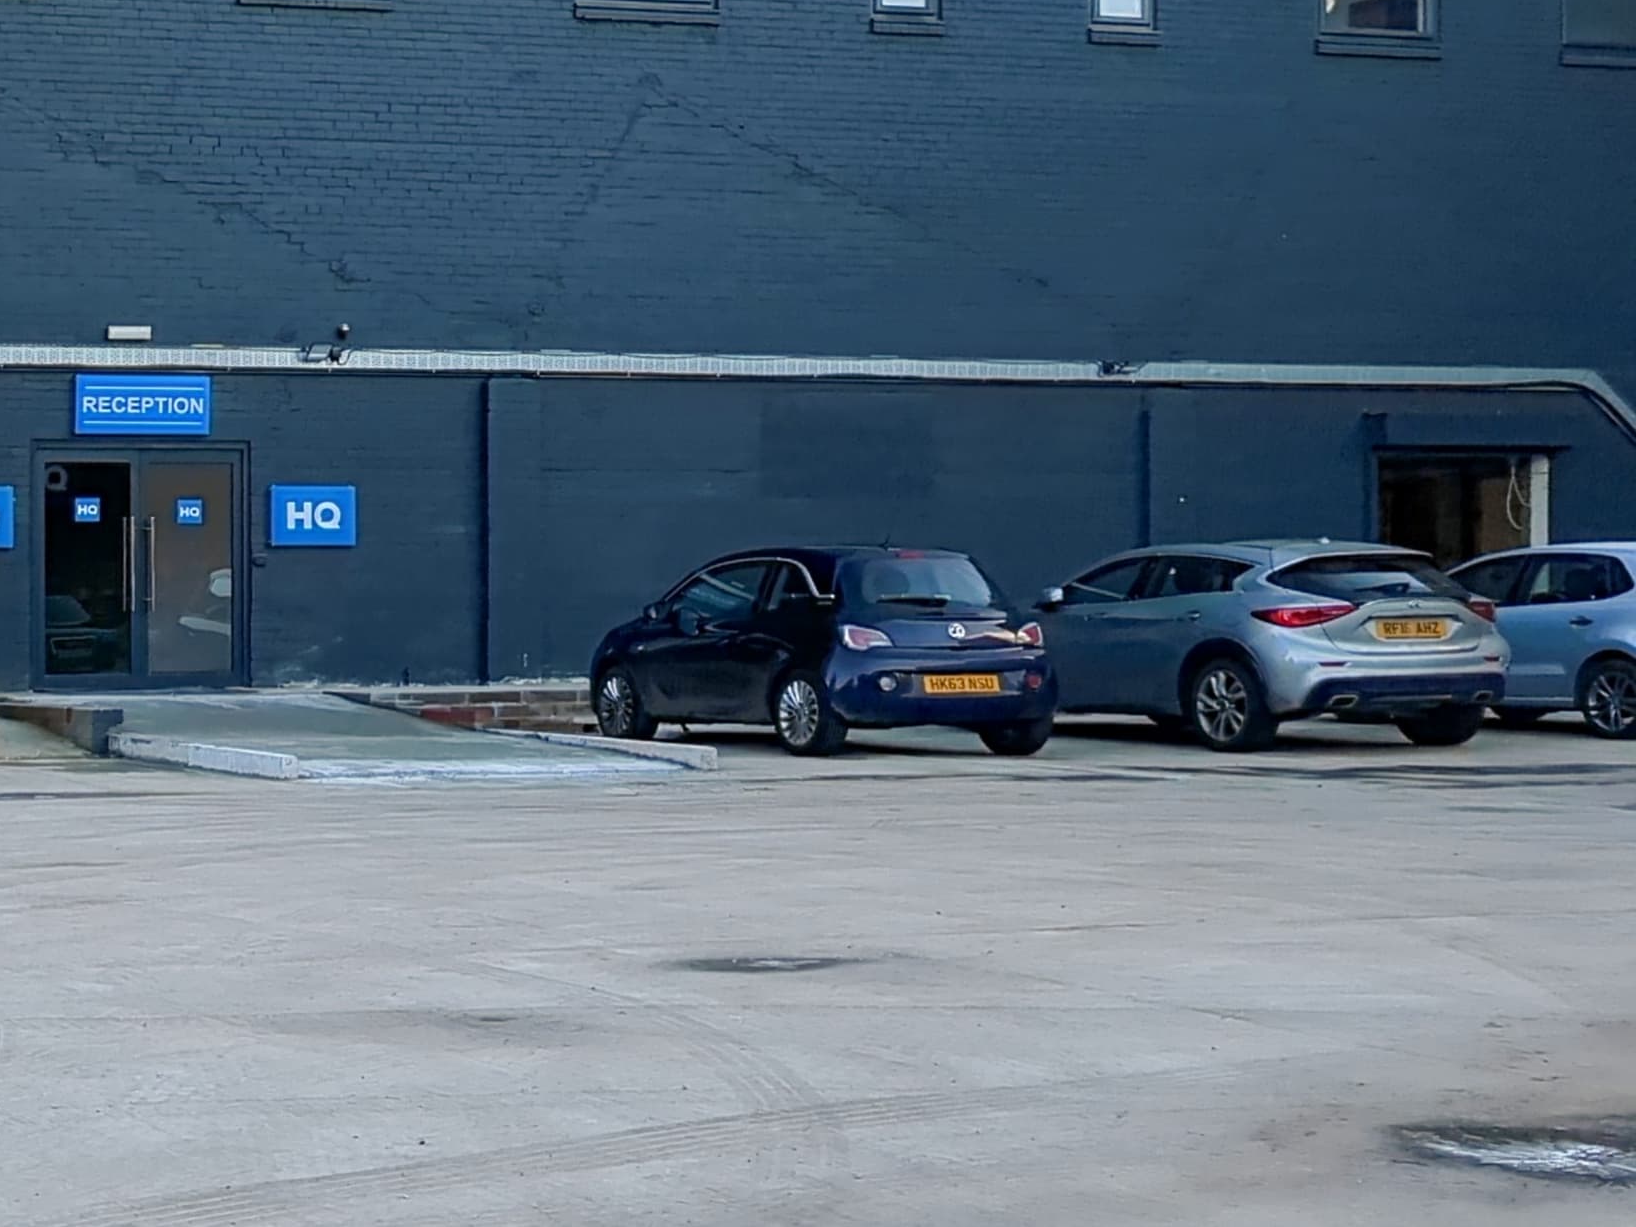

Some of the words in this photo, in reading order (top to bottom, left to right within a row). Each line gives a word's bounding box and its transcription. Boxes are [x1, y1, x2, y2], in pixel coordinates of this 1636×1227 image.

[82, 396, 204, 415] RECEPTION
[77, 504, 98, 515] HQ
[179, 506, 200, 517] HQ
[287, 501, 341, 530] HQ
[929, 676, 965, 690] HK63
[967, 676, 994, 690] NSU
